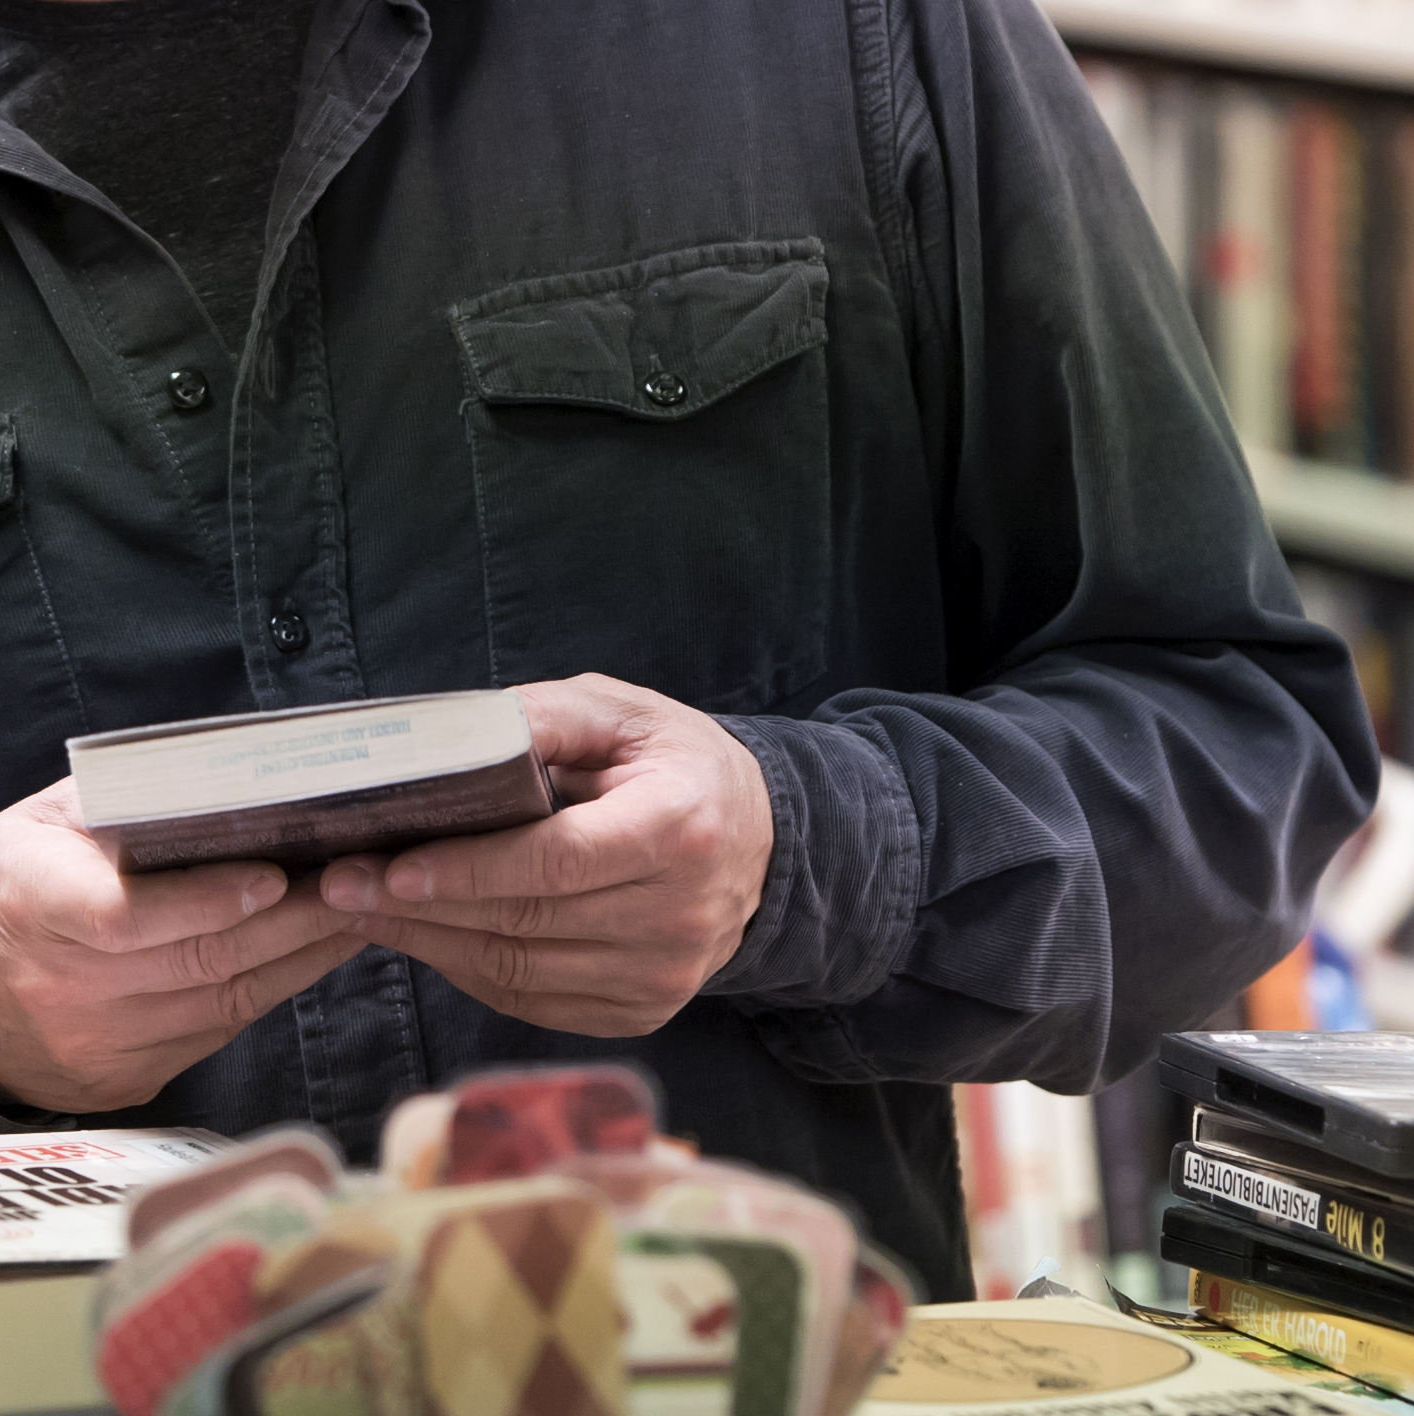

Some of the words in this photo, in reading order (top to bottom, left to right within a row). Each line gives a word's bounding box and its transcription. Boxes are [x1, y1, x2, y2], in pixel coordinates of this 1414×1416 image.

[1184, 1156, 1318, 1226] PASIENTBIBLIOTEKET
[1325, 1200, 1365, 1254] Mile
[1372, 1216, 1385, 1261] 8
[1283, 1311, 1347, 1366] HAROLD
